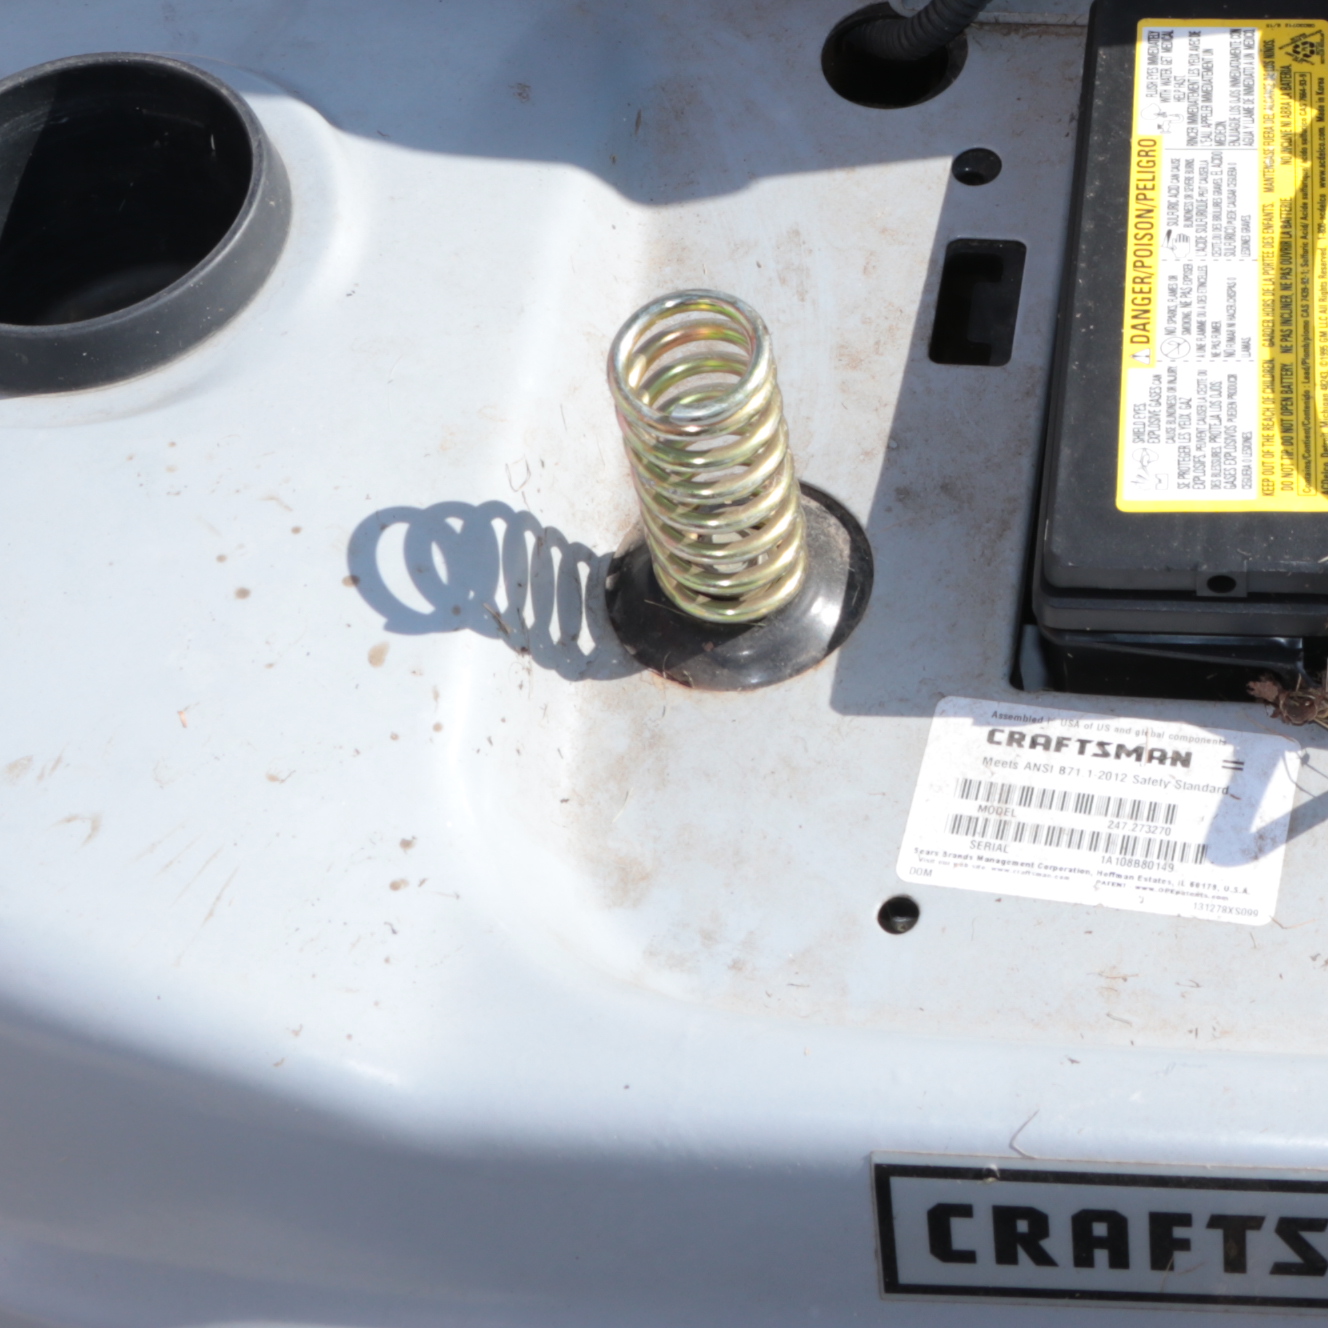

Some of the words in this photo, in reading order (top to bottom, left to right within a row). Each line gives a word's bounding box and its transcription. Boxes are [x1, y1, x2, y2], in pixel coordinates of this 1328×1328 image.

[1148, 31, 1160, 65] IMMEDIATELY
[1147, 68, 1158, 80] EYES
[1146, 82, 1158, 97] FLUSH
[1316, 78, 1324, 95] Korea
[1316, 105, 1324, 122] Made
[1262, 202, 1274, 234] ENFANTS.
[1129, 138, 1157, 345] DANGER/POISON/PELIGRO
[1280, 230, 1292, 238] LA
[1262, 236, 1274, 248] DES
[1280, 241, 1292, 265] OUVRIR
[1280, 267, 1292, 280] PAS
[1262, 278, 1275, 286] LA
[1280, 282, 1292, 291] NE
[1262, 288, 1274, 296] DE
[1262, 299, 1274, 317] HORS
[1319, 305, 1327, 314] All
[1319, 316, 1328, 328] LLC
[1262, 320, 1274, 347] GARDER
[1280, 329, 1292, 342] PAS
[1319, 331, 1328, 342] GM
[1280, 344, 1293, 354] NE
[1152, 374, 1162, 384] CAN
[1262, 358, 1275, 394] CHILDREN.
[1280, 362, 1293, 394] BATTERY.
[1149, 386, 1162, 407] GASES
[1262, 396, 1275, 404] OF
[1281, 397, 1293, 416] OPEN
[1148, 410, 1161, 444] EXPLOSIVE
[1262, 408, 1275, 431] REACH
[1280, 418, 1294, 433] NOT
[1132, 421, 1146, 444] SHIELD
[1262, 434, 1274, 447] THE
[1281, 436, 1294, 446] DO
[1262, 449, 1274, 458] OF
[1281, 448, 1294, 460] TIP.
[1262, 461, 1274, 475] OUT
[1281, 463, 1294, 478] NOT
[1262, 478, 1274, 496] KEEP
[1281, 481, 1294, 491] DO
[992, 711, 1043, 723] Assembled
[1060, 718, 1079, 728] USA
[1097, 723, 1110, 732] US
[1169, 732, 1227, 745] components
[986, 728, 1192, 768] CRAFTSMAN
[982, 757, 1018, 770] Meets
[1024, 762, 1053, 774] ANSI
[1132, 775, 1170, 789] Safety
[1175, 779, 1230, 795] Standard
[978, 804, 1017, 818] MODEL
[1108, 820, 1171, 836] 247.273270
[969, 840, 1009, 854] SERIAL
[910, 867, 932, 877] DOM
[914, 848, 938, 857] Sears
[943, 850, 973, 861] Brands
[977, 855, 1034, 869] Management
[1097, 870, 1134, 881] Hoffman
